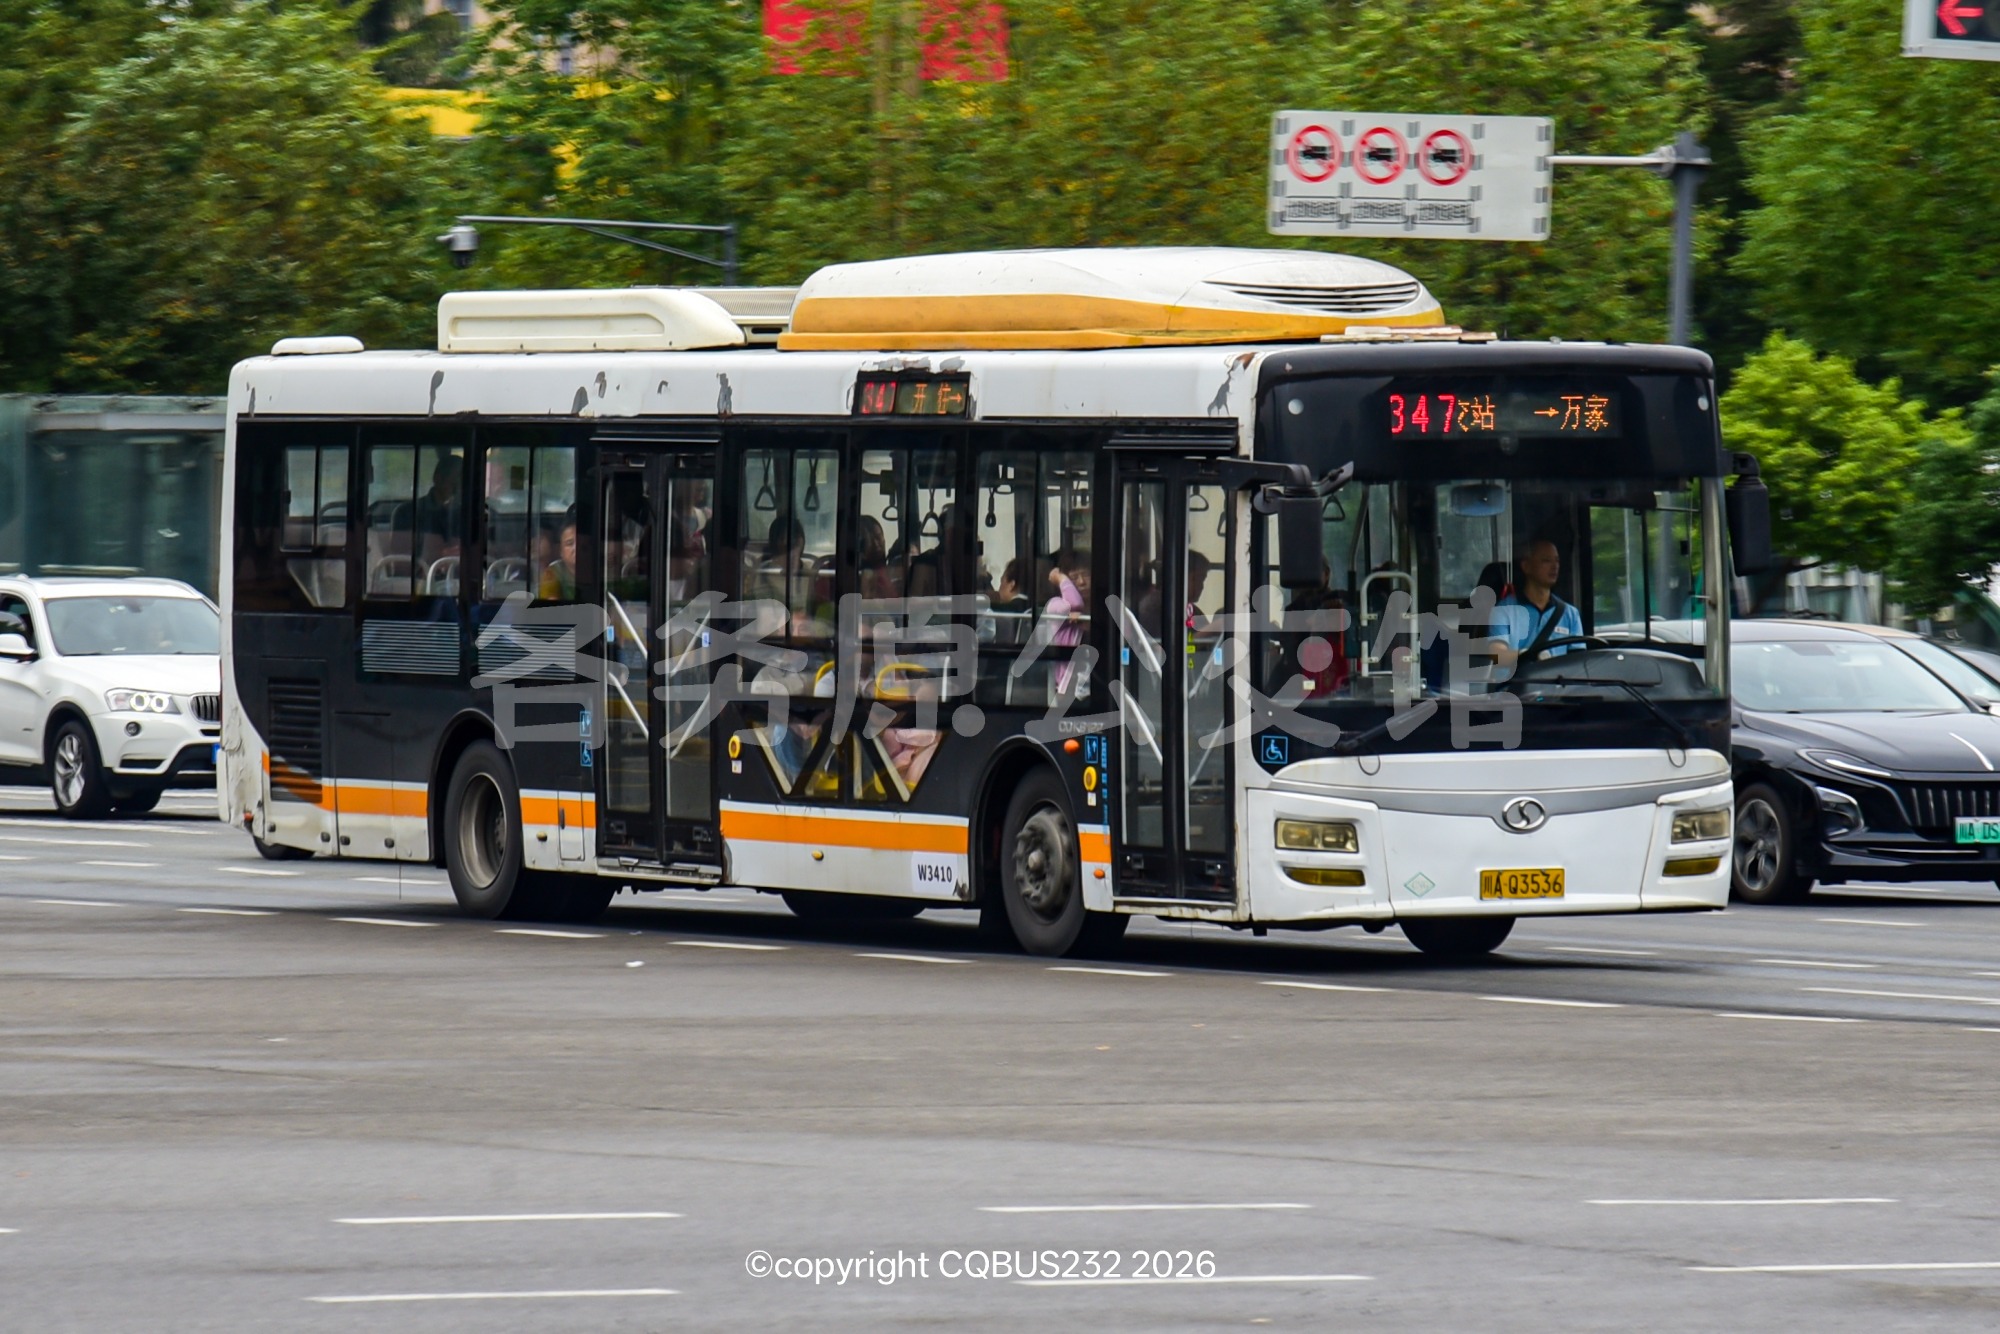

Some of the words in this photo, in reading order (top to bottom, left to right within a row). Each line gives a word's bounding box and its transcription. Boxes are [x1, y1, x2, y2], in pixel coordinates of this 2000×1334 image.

[1389, 395, 1456, 432] 347
[1560, 395, 1609, 431] 万家
[917, 863, 953, 883] W3410
